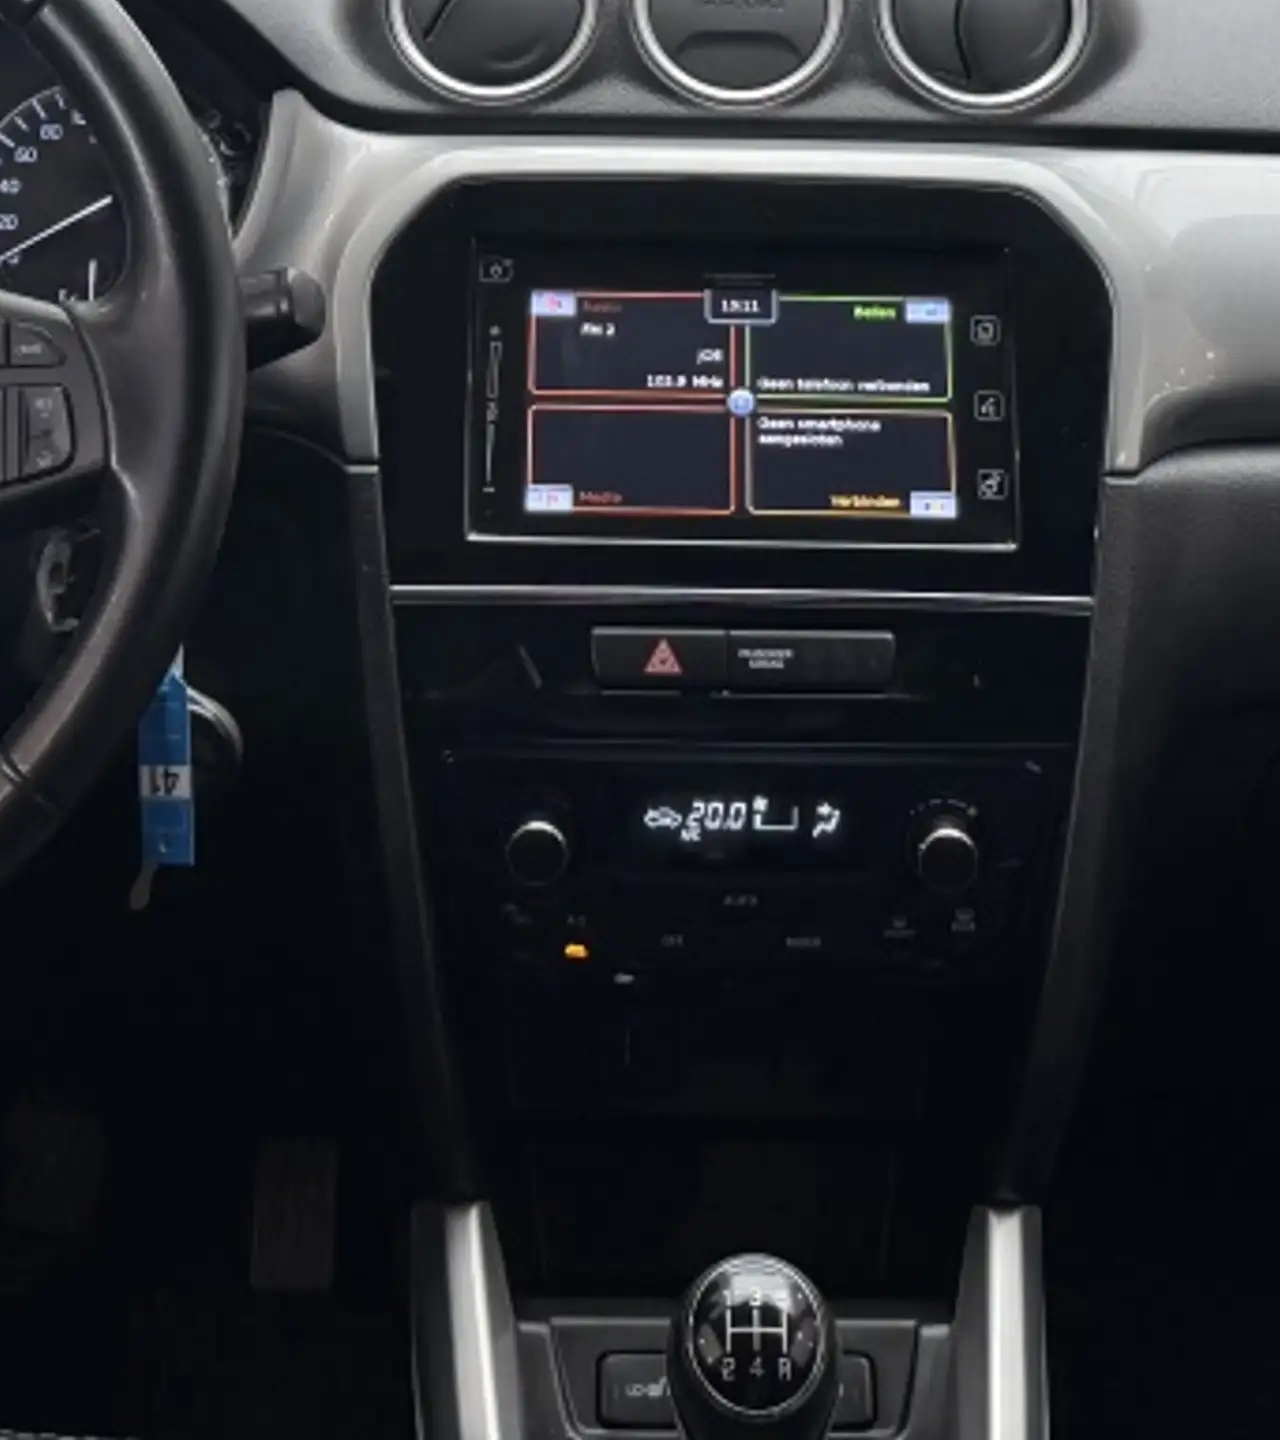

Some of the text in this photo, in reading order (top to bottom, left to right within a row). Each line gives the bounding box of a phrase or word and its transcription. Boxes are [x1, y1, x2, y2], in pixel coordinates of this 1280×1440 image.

[685, 799, 748, 831] 20.0
[722, 1355, 792, 1382] 2 4 R
